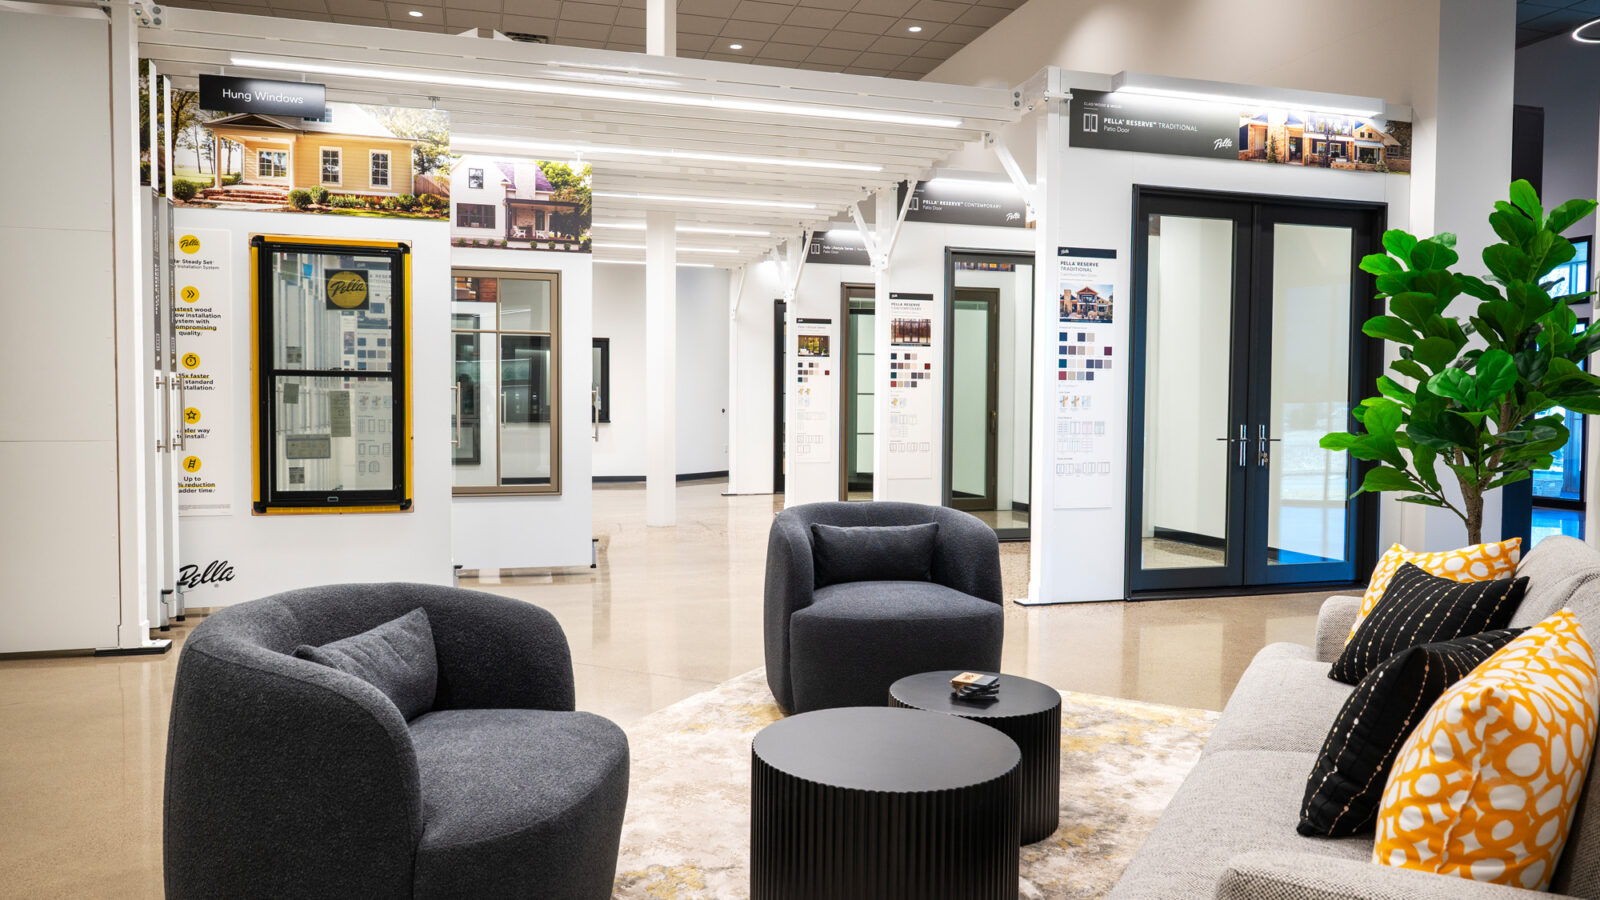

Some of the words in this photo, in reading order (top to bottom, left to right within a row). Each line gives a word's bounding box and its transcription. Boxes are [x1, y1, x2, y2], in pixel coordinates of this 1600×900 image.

[222, 88, 252, 103] Hung
[254, 90, 304, 104] Windows
[1158, 122, 1198, 132] TRADITIONAL
[1213, 138, 1233, 150] Pella
[180, 239, 200, 249] Pella
[330, 279, 364, 298] Pella
[179, 560, 236, 589] Pella
